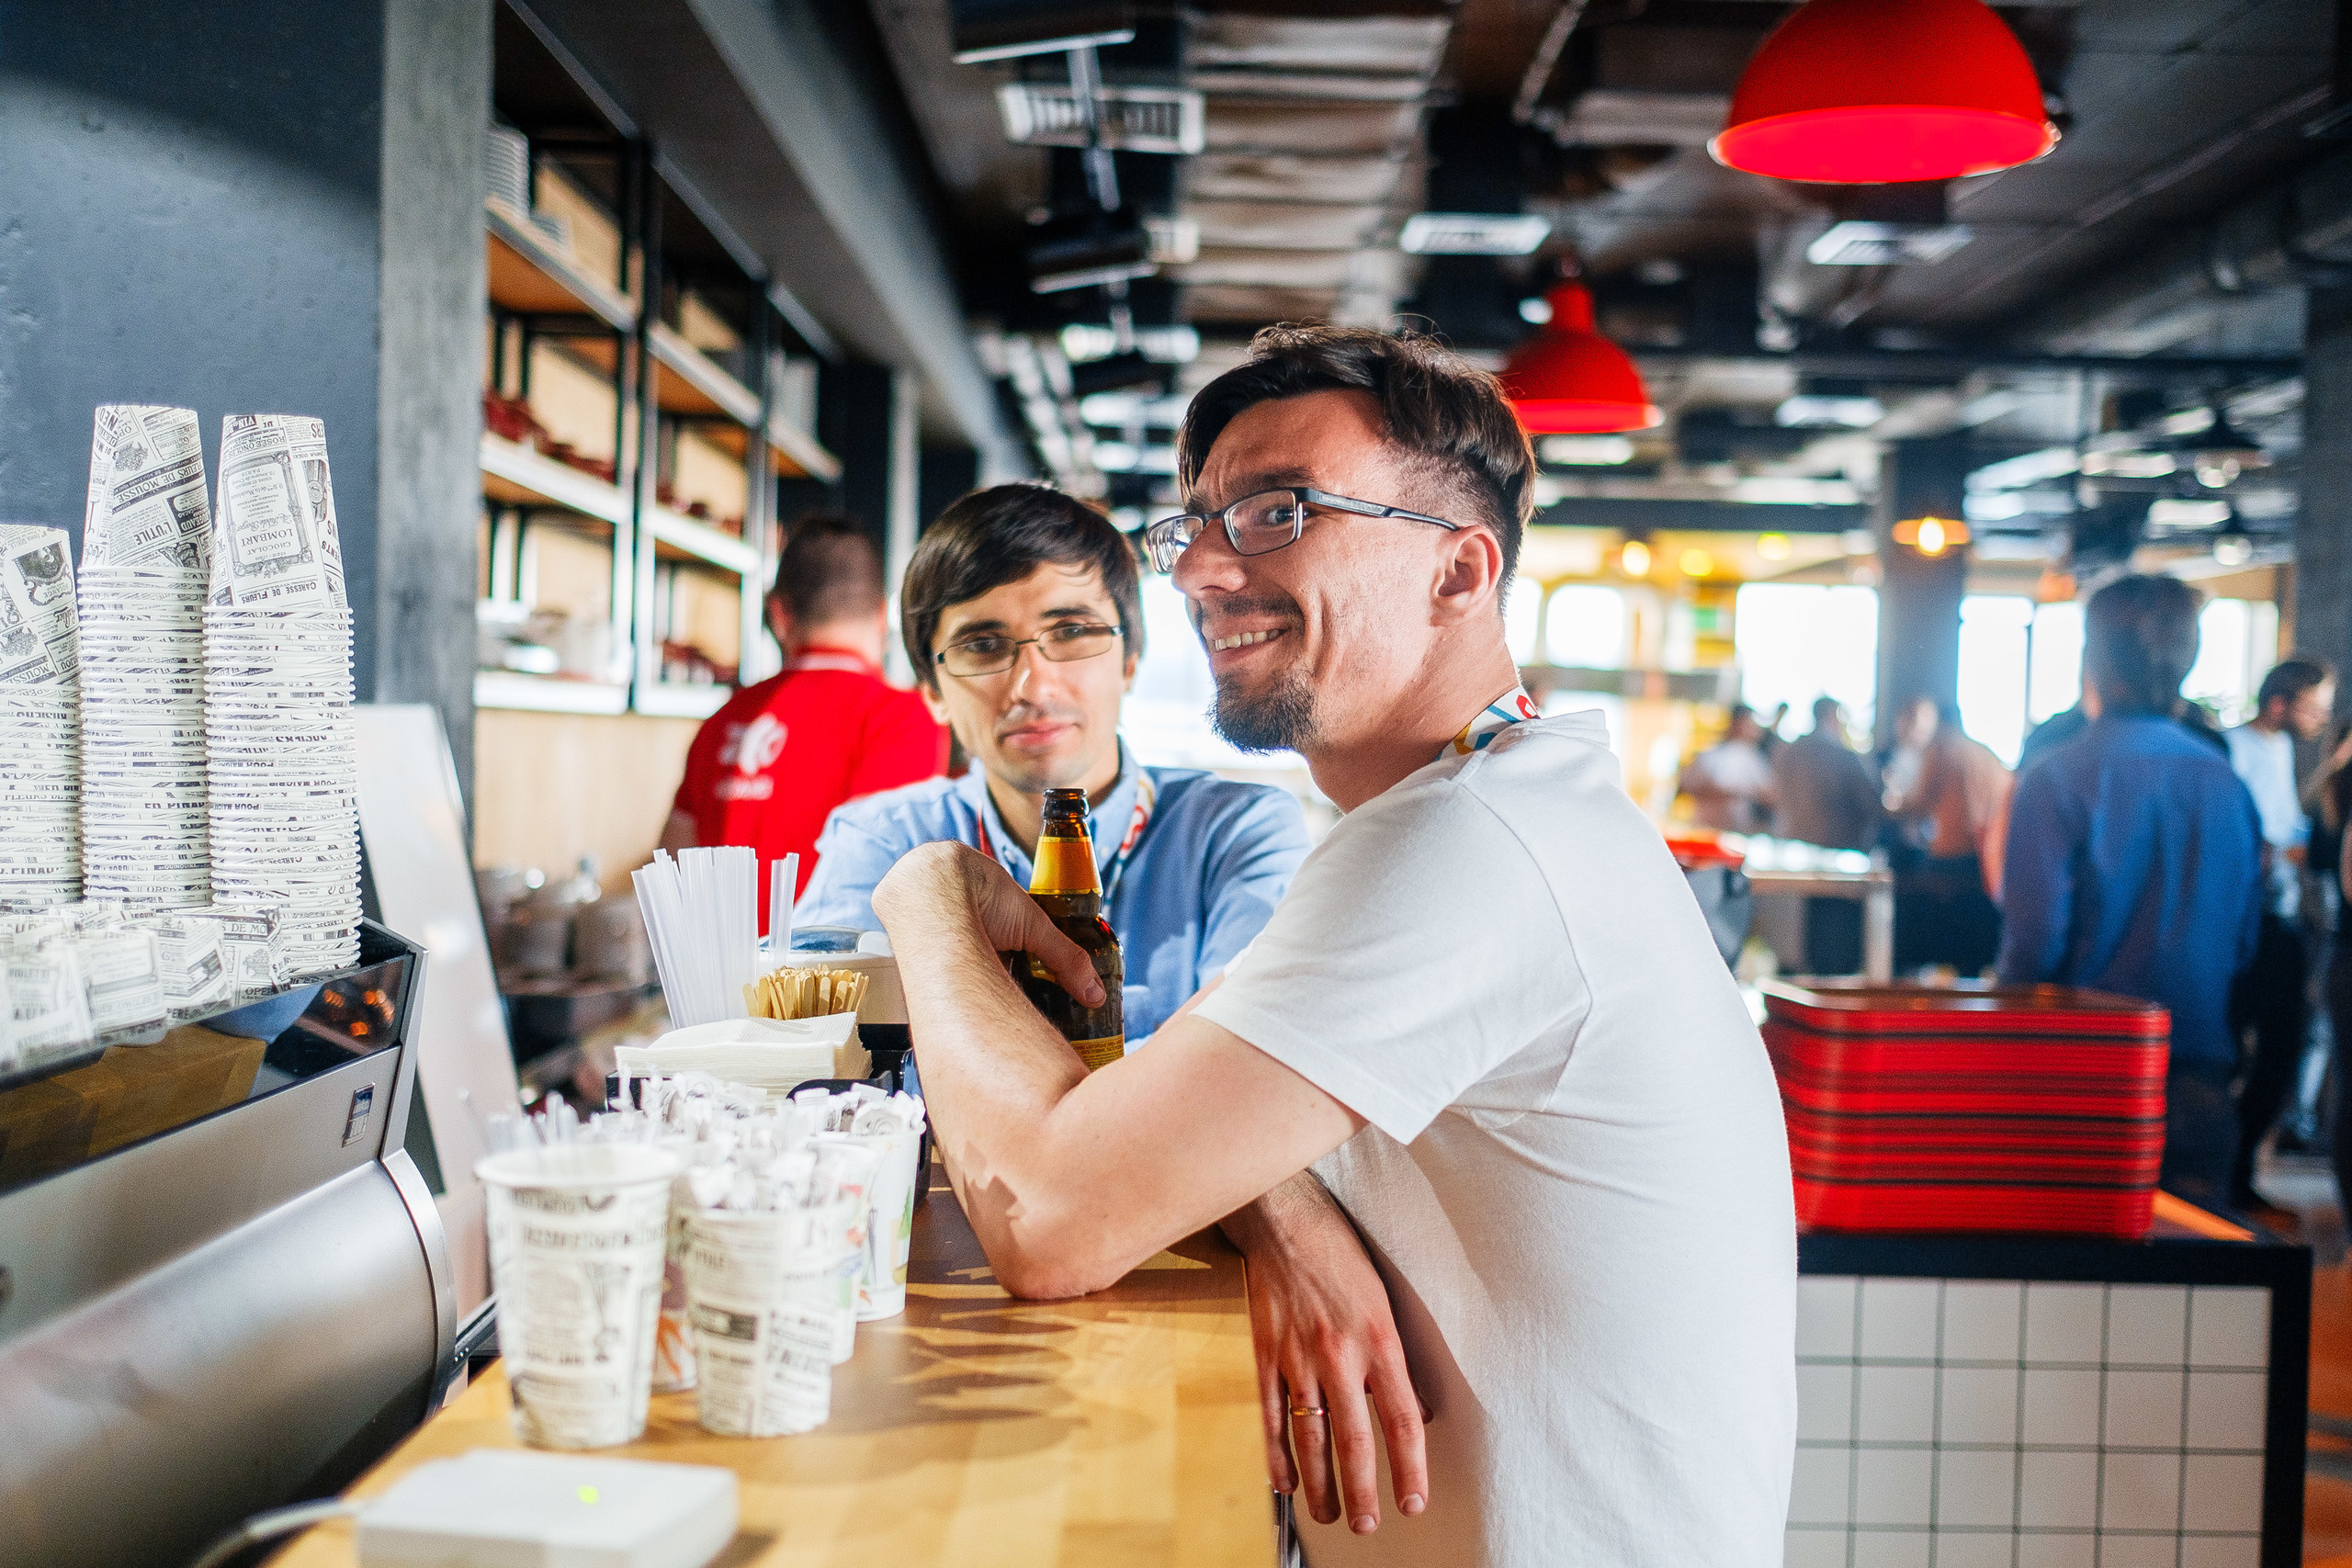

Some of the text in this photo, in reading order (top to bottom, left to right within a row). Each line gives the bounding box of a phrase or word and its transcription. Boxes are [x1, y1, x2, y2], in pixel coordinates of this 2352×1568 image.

[176, 460, 202, 476] FLEURS
[161, 471, 175, 482] DE
[133, 521, 172, 546] L'UTILE
[240, 528, 292, 547] LOMBART
[246, 541, 291, 556] CHOCOLAT
[272, 589, 281, 597] DE
[285, 581, 317, 595] CARESSE
[241, 591, 268, 604] FLEURS
[231, 922, 246, 932] DE
